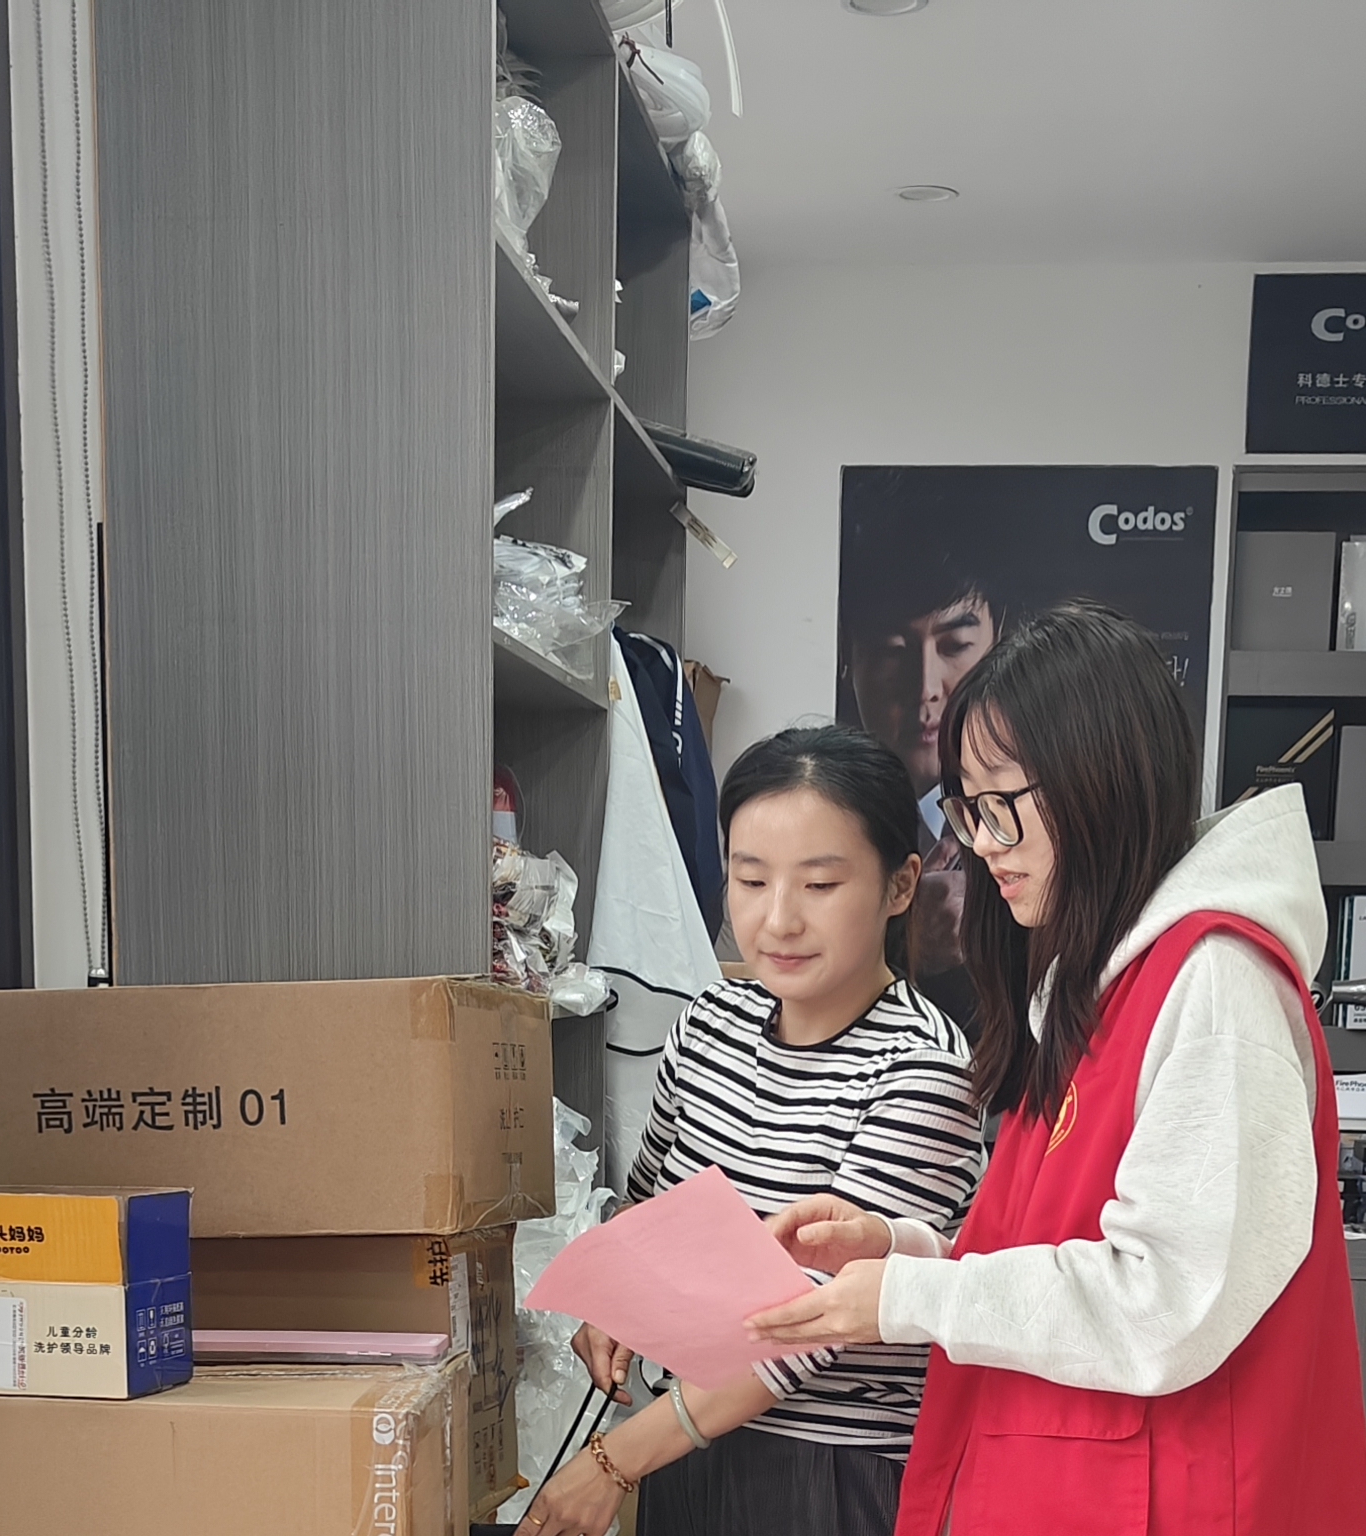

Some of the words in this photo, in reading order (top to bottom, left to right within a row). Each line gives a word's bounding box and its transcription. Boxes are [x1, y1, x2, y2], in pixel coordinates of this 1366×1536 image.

[1087, 504, 1186, 545] Codos
[32, 1087, 225, 1135] 高端定制
[238, 1088, 289, 1126] 01
[46, 1326, 99, 1339] 儿童分龄
[33, 1341, 112, 1356] 洗护领导品牌
